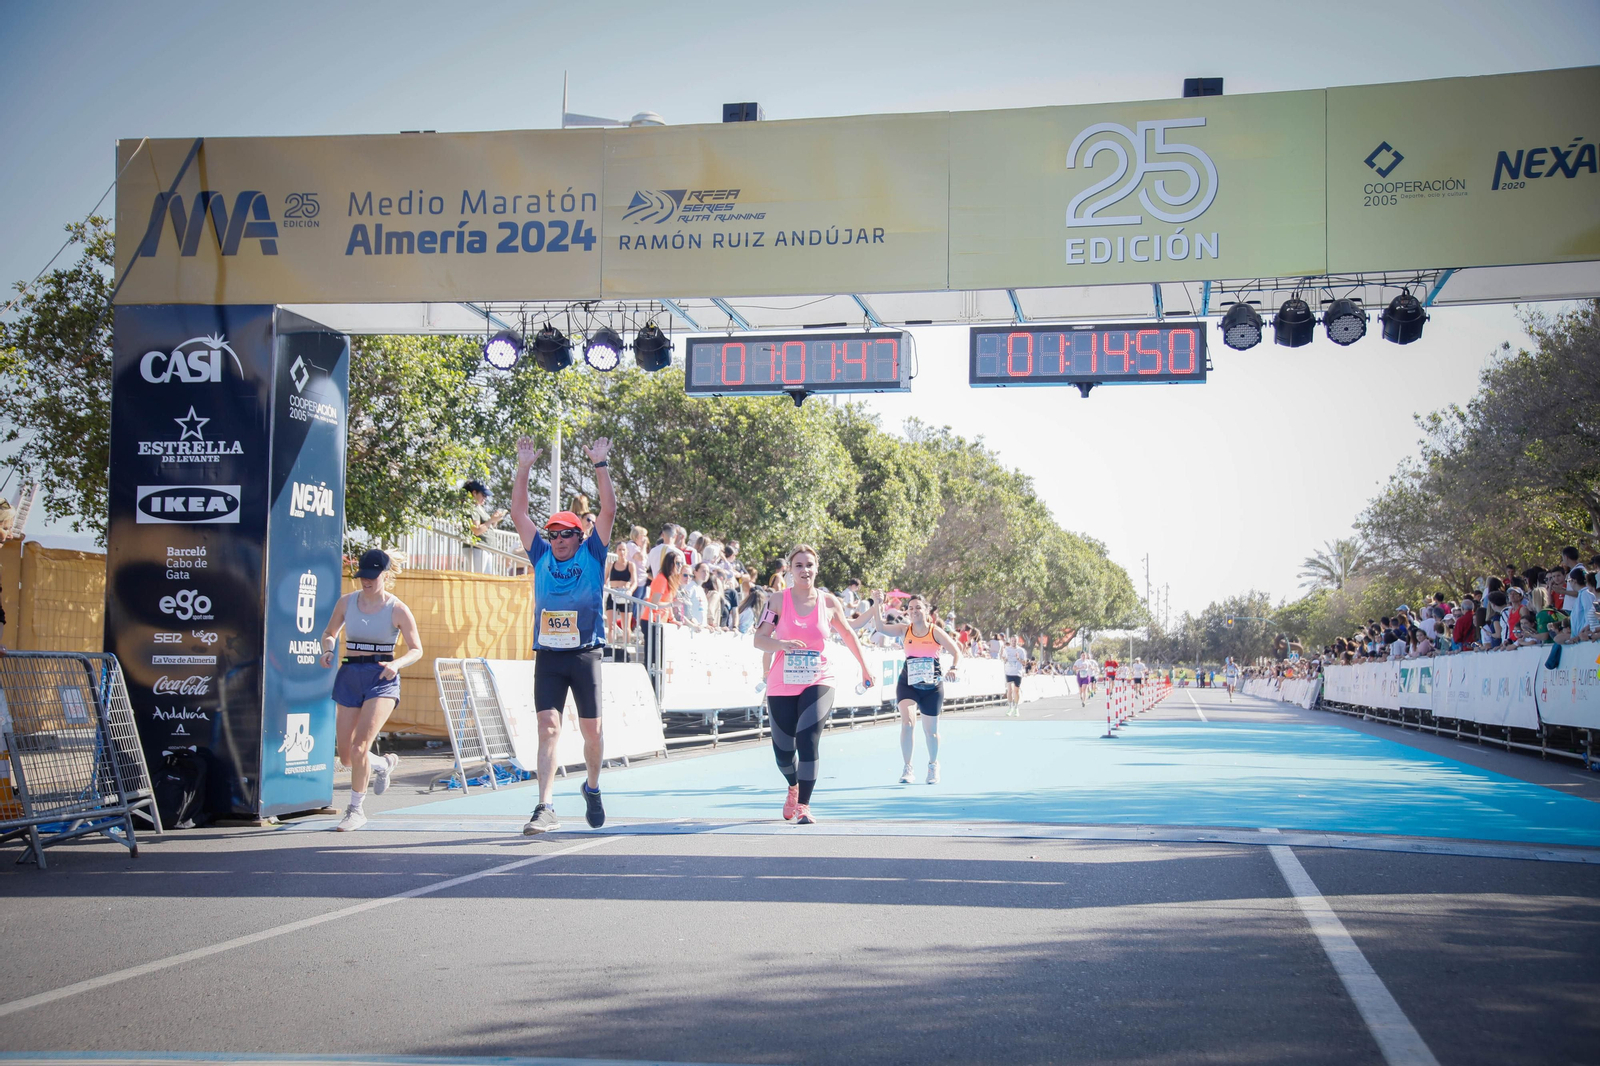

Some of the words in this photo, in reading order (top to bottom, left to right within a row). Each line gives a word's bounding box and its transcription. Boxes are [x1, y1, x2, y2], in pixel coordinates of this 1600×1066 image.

[1066, 116, 1219, 227] 25
[1364, 177, 1466, 194] COOPERACIÓN
[1501, 181, 1526, 190] 2020
[348, 190, 444, 216] Medio
[461, 187, 597, 214] Maratón
[687, 189, 741, 203] RFEA
[1364, 195, 1398, 207] 2005
[284, 193, 320, 218] 25
[682, 203, 735, 213] SERIES
[284, 219, 320, 228] EDICIÓN
[677, 214, 711, 223] RUTA
[714, 212, 766, 222] RUNNING
[345, 219, 486, 255] Almería
[496, 219, 597, 253] 2024
[619, 230, 702, 250] RAMÓN
[713, 231, 765, 249] RUIZ
[774, 225, 885, 247] ANDÚJAR
[1066, 228, 1219, 265] EDICIÓN
[1007, 329, 1195, 377] 01:14:50
[139, 350, 222, 384] CASI
[289, 394, 338, 420] COOPERACIÓN
[289, 407, 307, 422] 2005
[137, 441, 244, 455] ESTRELLA
[161, 455, 175, 463] DE
[176, 455, 220, 463] LEVANTE
[150, 496, 229, 512] IKEA
[166, 546, 207, 556] Barceló
[166, 558, 193, 568] Cabo
[194, 558, 208, 568] de
[166, 569, 190, 580] Gata
[159, 589, 212, 620] ego
[548, 617, 571, 629] 464
[289, 638, 322, 655] ALMERÍA
[186, 656, 215, 664] Almería
[153, 675, 213, 695] Coca-Cola
[152, 705, 211, 721] Andalucía
